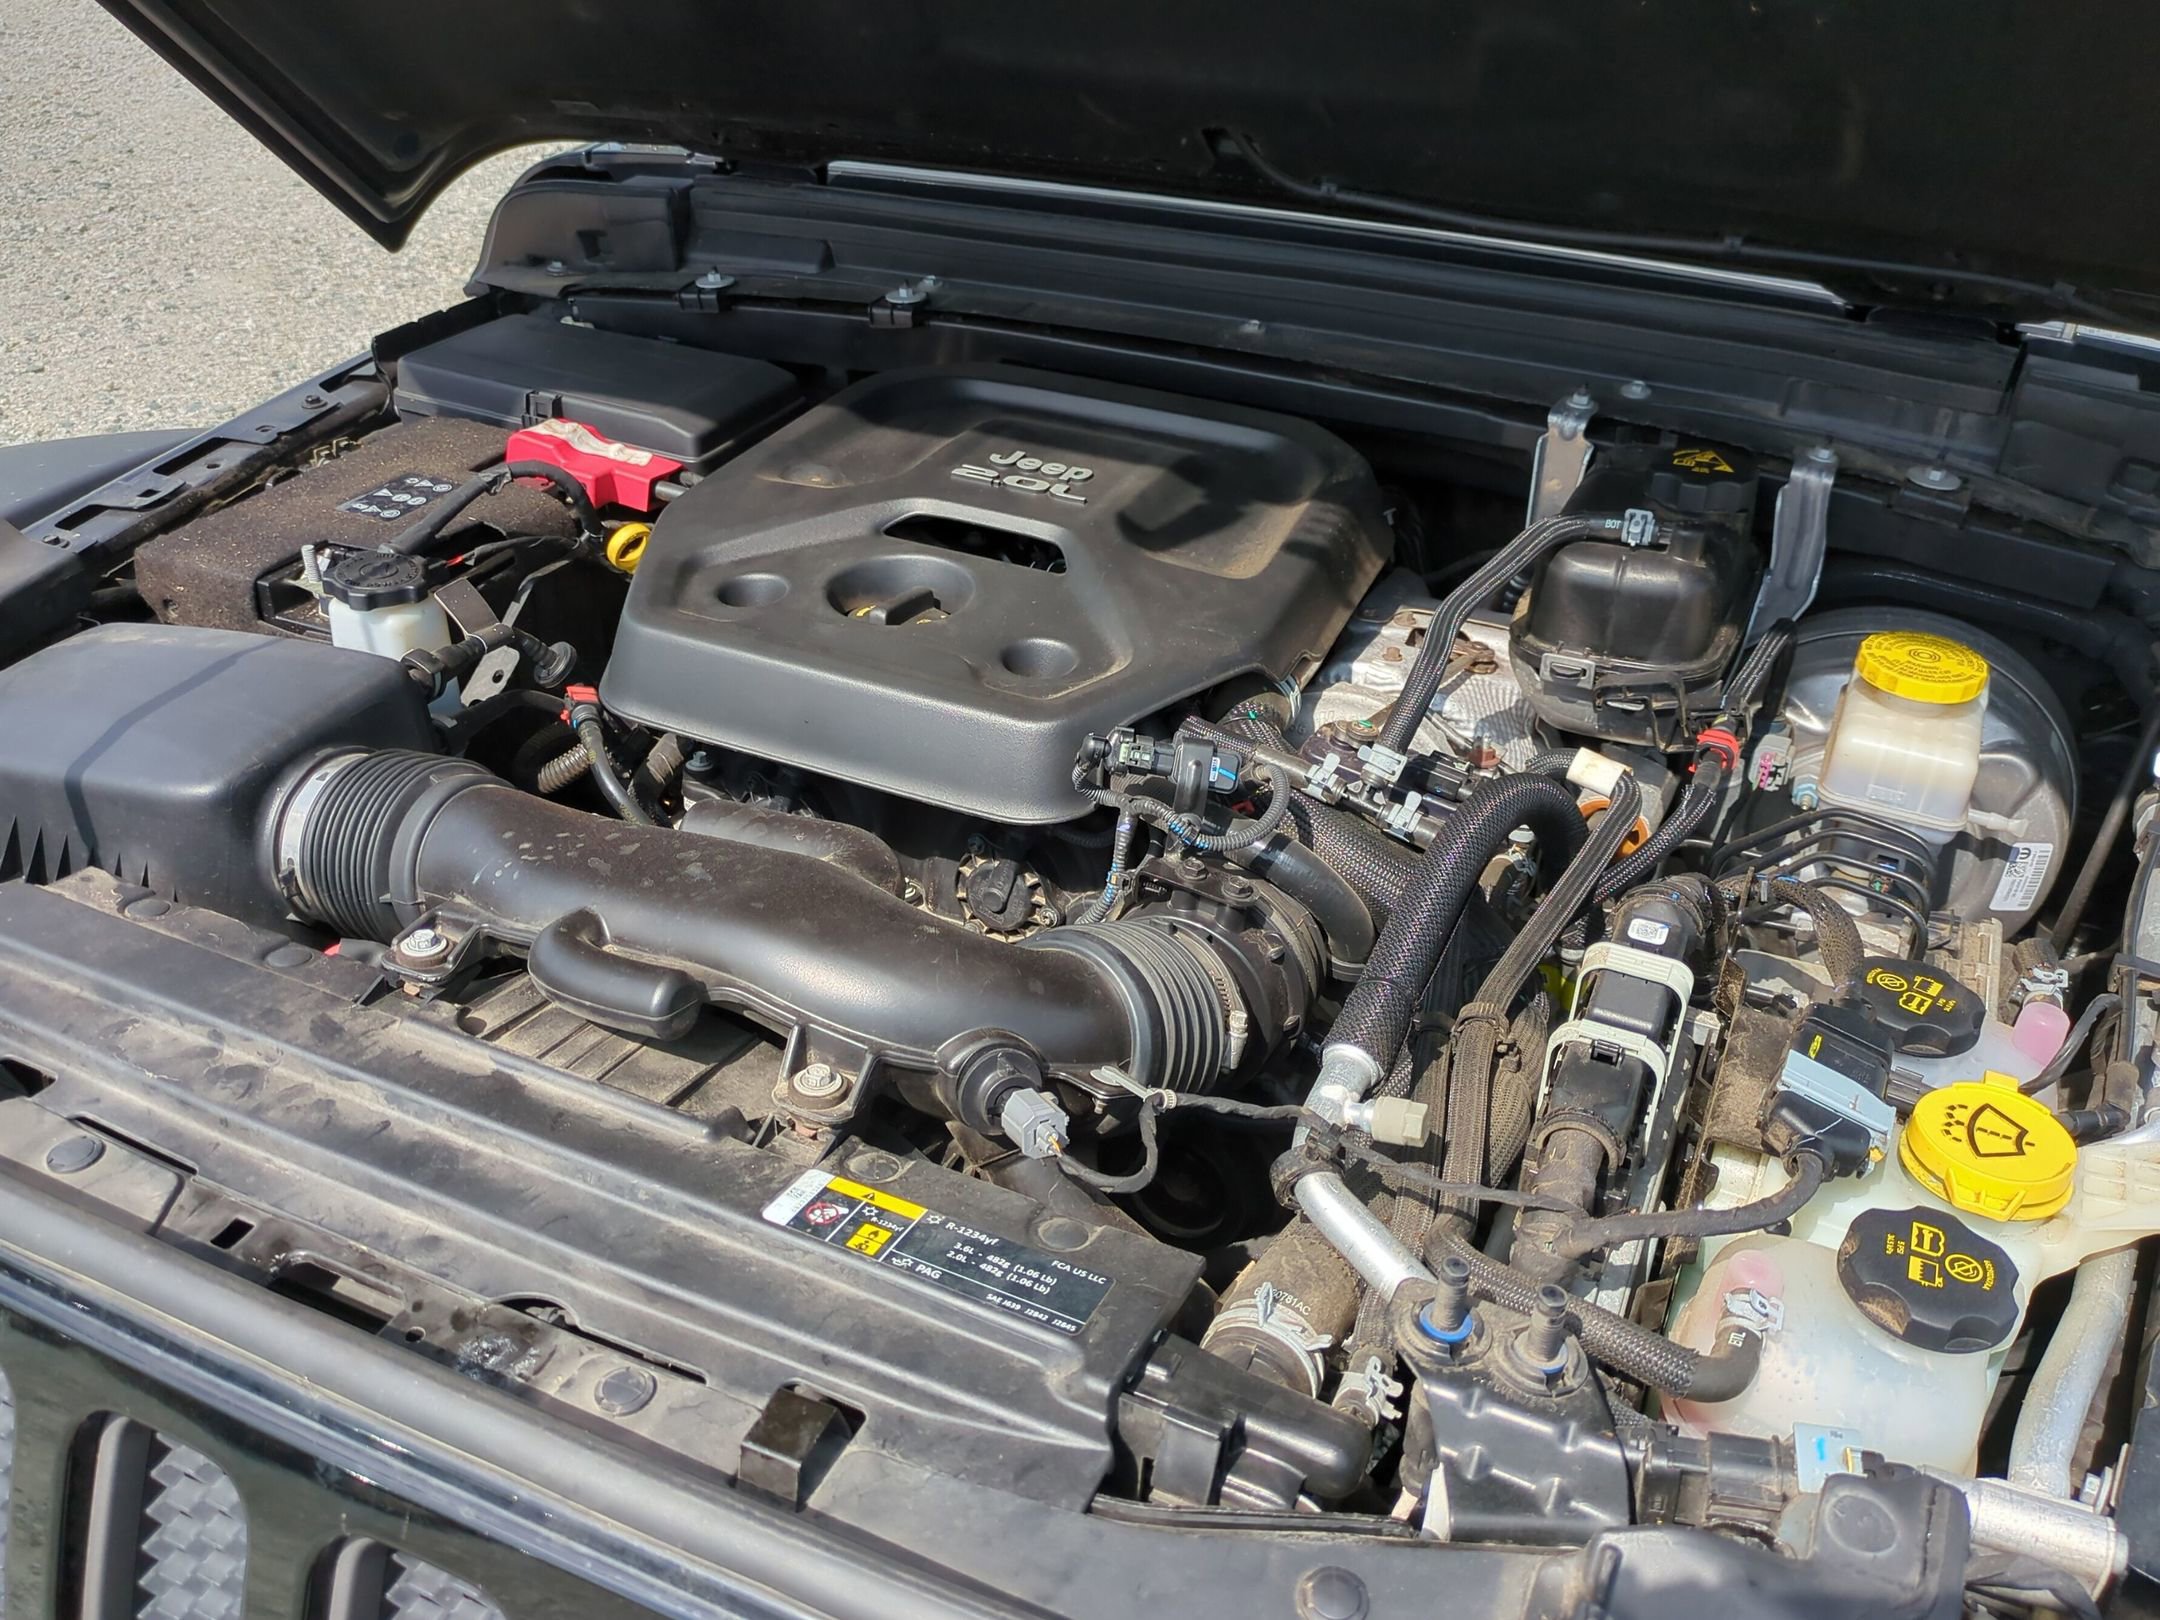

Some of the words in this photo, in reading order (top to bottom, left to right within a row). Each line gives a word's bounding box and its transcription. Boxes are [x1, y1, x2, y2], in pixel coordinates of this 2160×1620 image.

[989, 450, 1093, 482] Jeep
[951, 463, 1087, 504] 2.0L
[1604, 518, 1622, 529] BOT
[945, 1221, 999, 1246] R-1234yf
[914, 1263, 942, 1280] PAG
[945, 1250, 967, 1264] 2.0L
[979, 1262, 1004, 1278] 482g
[1006, 1272, 1033, 1288] (1.06
[1033, 1282, 1051, 1296] Lb)
[953, 1242, 975, 1256] 3.6L
[986, 1253, 1011, 1269] 482g
[1013, 1264, 1040, 1280] (1.06
[1040, 1273, 1058, 1287] Lb)
[1051, 1260, 1071, 1272] FCA
[1072, 1267, 1087, 1278] US
[1087, 1272, 1107, 1285] LLC
[986, 1293, 1003, 1305] SAE
